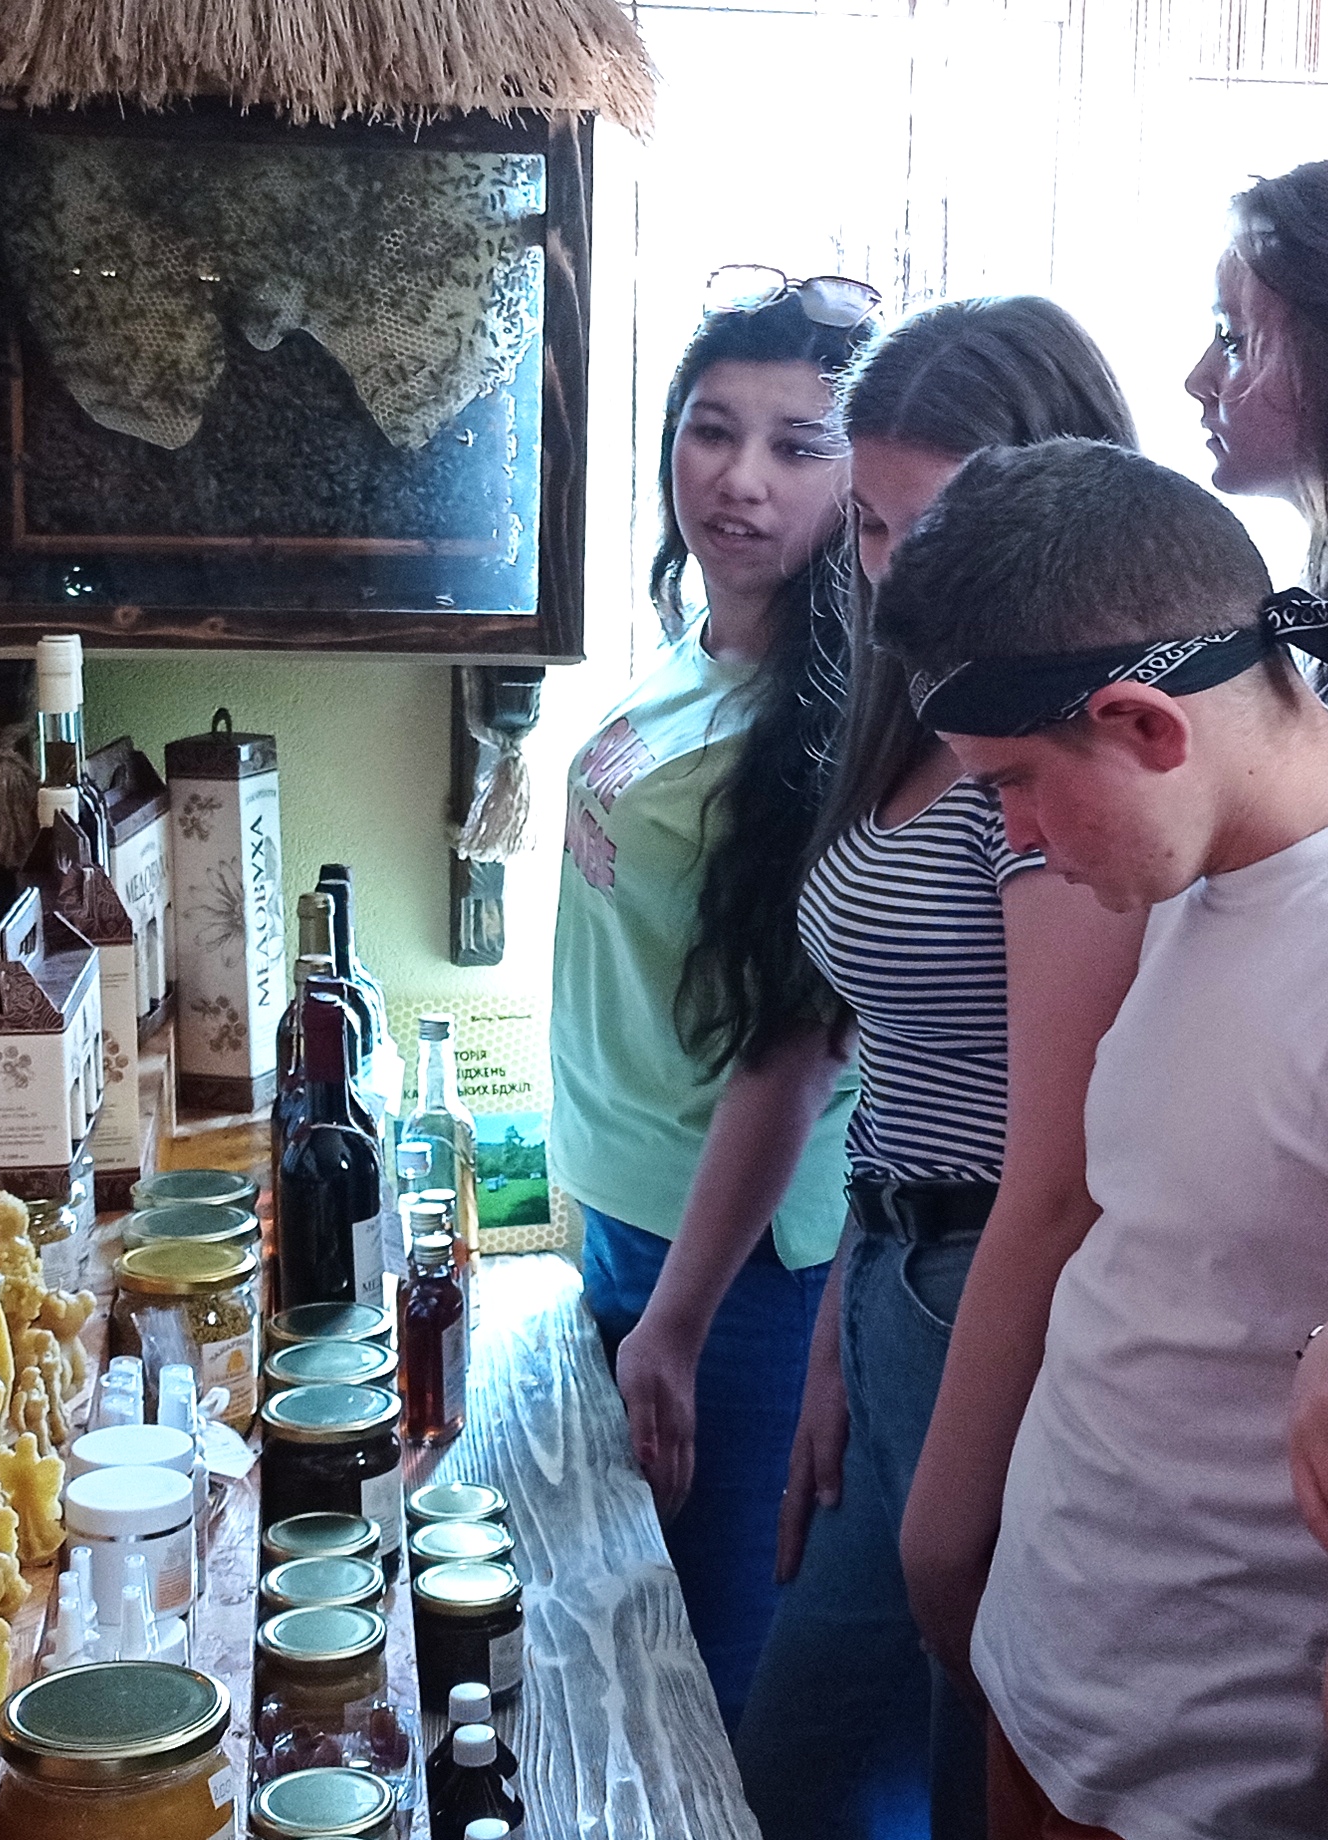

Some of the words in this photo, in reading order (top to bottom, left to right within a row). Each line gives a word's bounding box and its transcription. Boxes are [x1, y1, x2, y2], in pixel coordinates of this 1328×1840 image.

[454, 1051, 487, 1062] ТОРІЯ
[457, 1067, 506, 1079] ІДЖЕНЬ
[492, 1083, 531, 1096] БДЖІЛ
